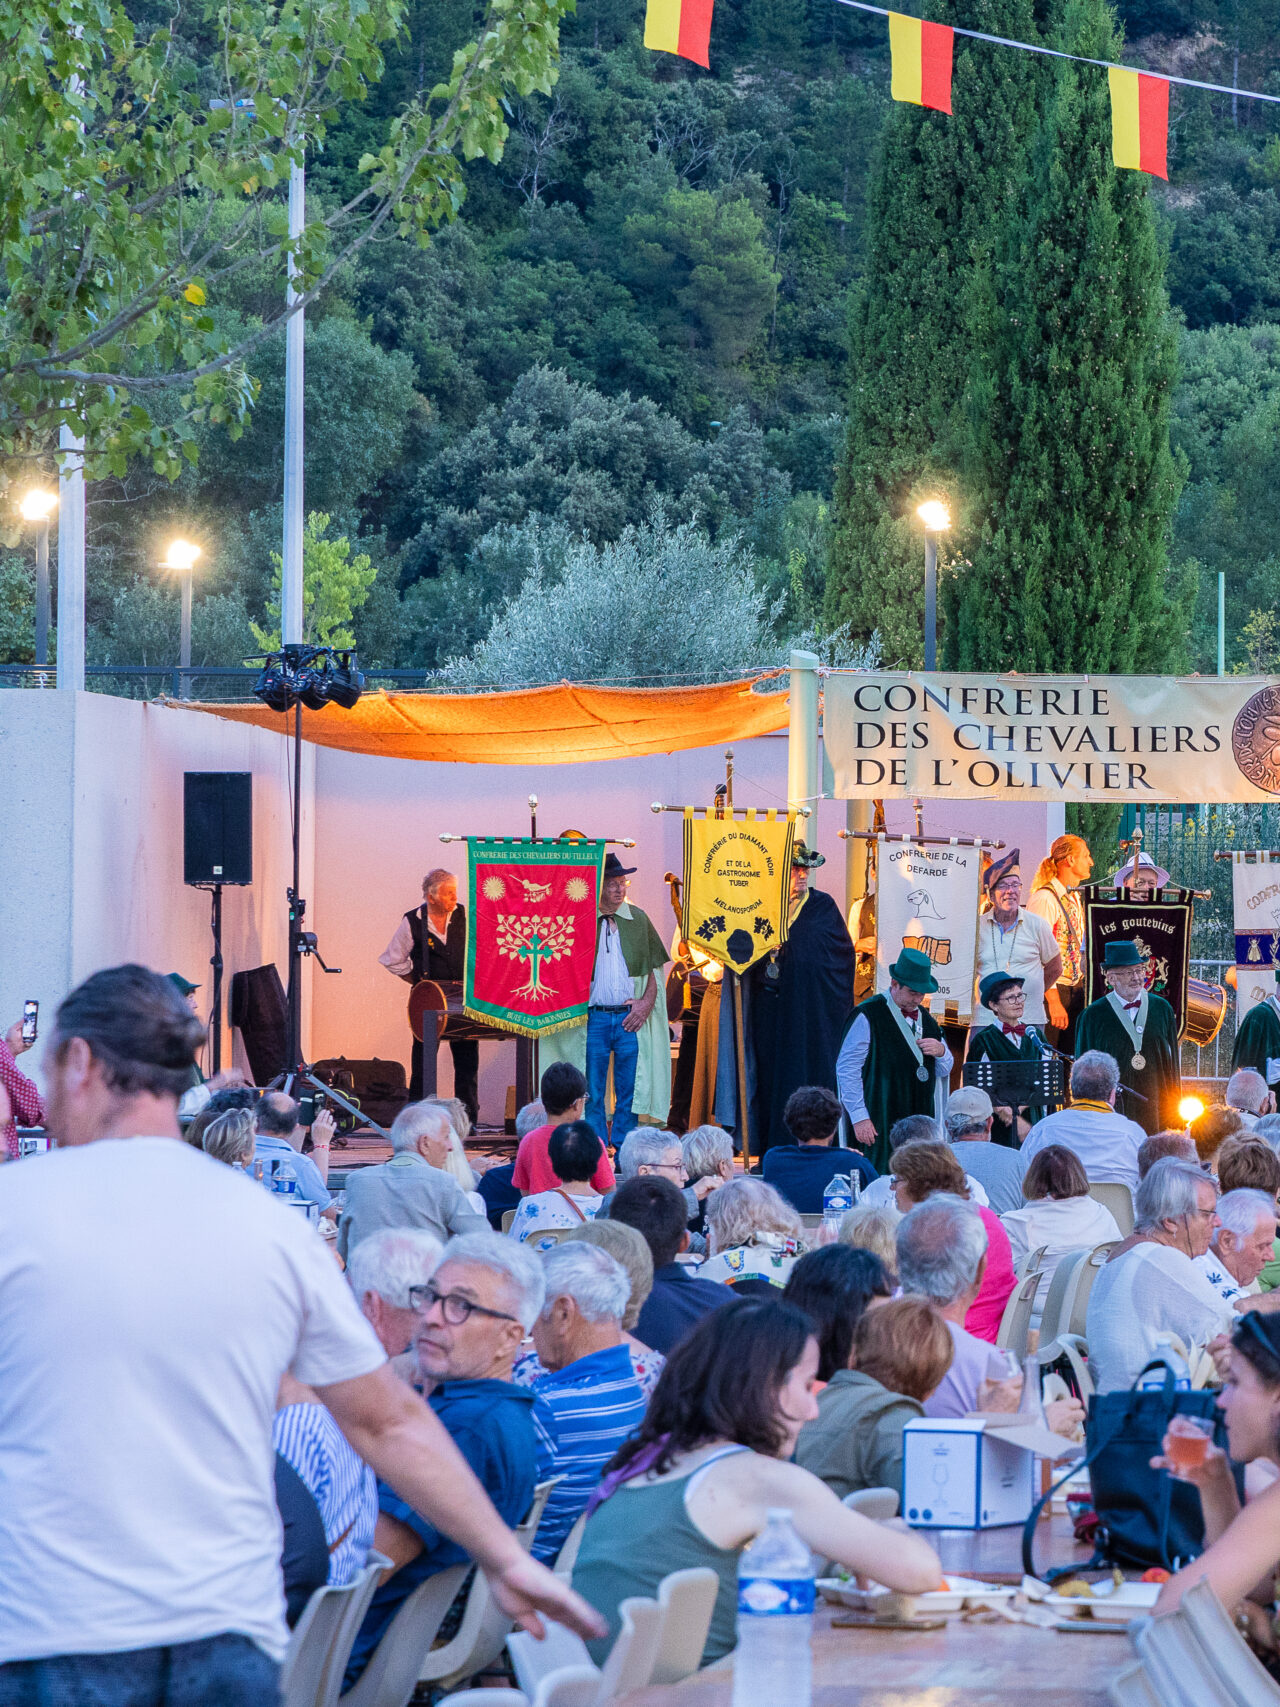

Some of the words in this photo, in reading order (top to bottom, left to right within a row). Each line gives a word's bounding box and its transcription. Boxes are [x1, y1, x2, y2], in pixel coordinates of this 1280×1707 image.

[853, 684, 1110, 716] CONFRERIE
[853, 721, 930, 750] DES
[953, 722, 1221, 753] CHEVALIERS
[1236, 741, 1253, 758] DE
[853, 758, 907, 787] DE
[932, 759, 1156, 790] L'OLIVIER
[728, 832, 738, 840] DU
[739, 832, 769, 854] DIAMANT
[766, 856, 774, 877] NOIR
[889, 849, 940, 862] CONFRERIE
[942, 852, 954, 862] DE
[955, 856, 967, 868] LA
[735, 860, 742, 868] DE
[906, 864, 948, 877] DEFARDE
[717, 869, 761, 878] GASTRONOMIE
[729, 879, 749, 887] TUBER
[713, 897, 763, 915] MELANOSPORUM
[1099, 921, 1117, 935] les
[1122, 917, 1176, 934] goutevins
[937, 986, 951, 994] 005
